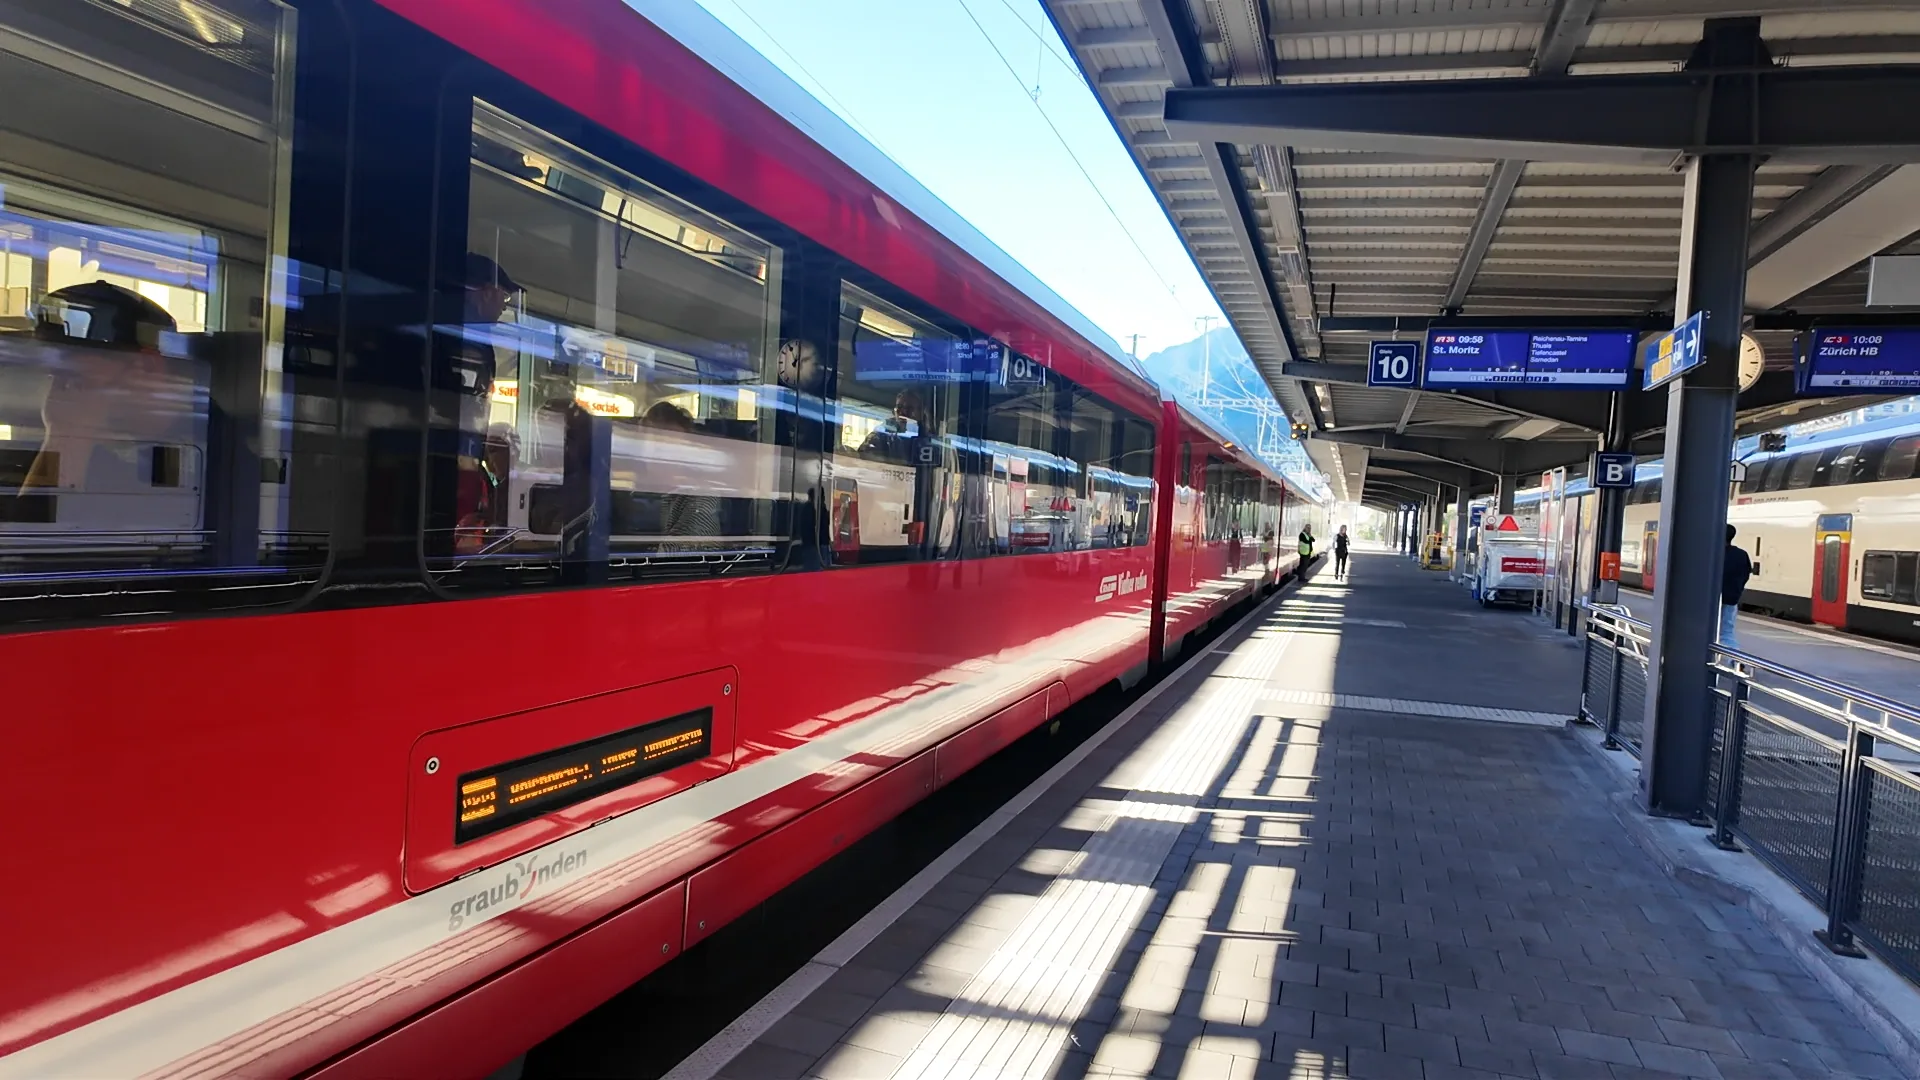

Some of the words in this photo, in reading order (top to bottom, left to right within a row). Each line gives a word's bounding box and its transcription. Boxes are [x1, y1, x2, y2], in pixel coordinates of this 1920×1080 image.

[1458, 335, 1484, 344] 09:58
[1853, 335, 1883, 344] 10:08
[1433, 345, 1447, 354] St.
[1448, 345, 1480, 354] Moritz
[1819, 347, 1857, 356] Zürich
[1859, 347, 1879, 356] HB
[1378, 355, 1409, 379] 10
[1606, 463, 1623, 481] B
